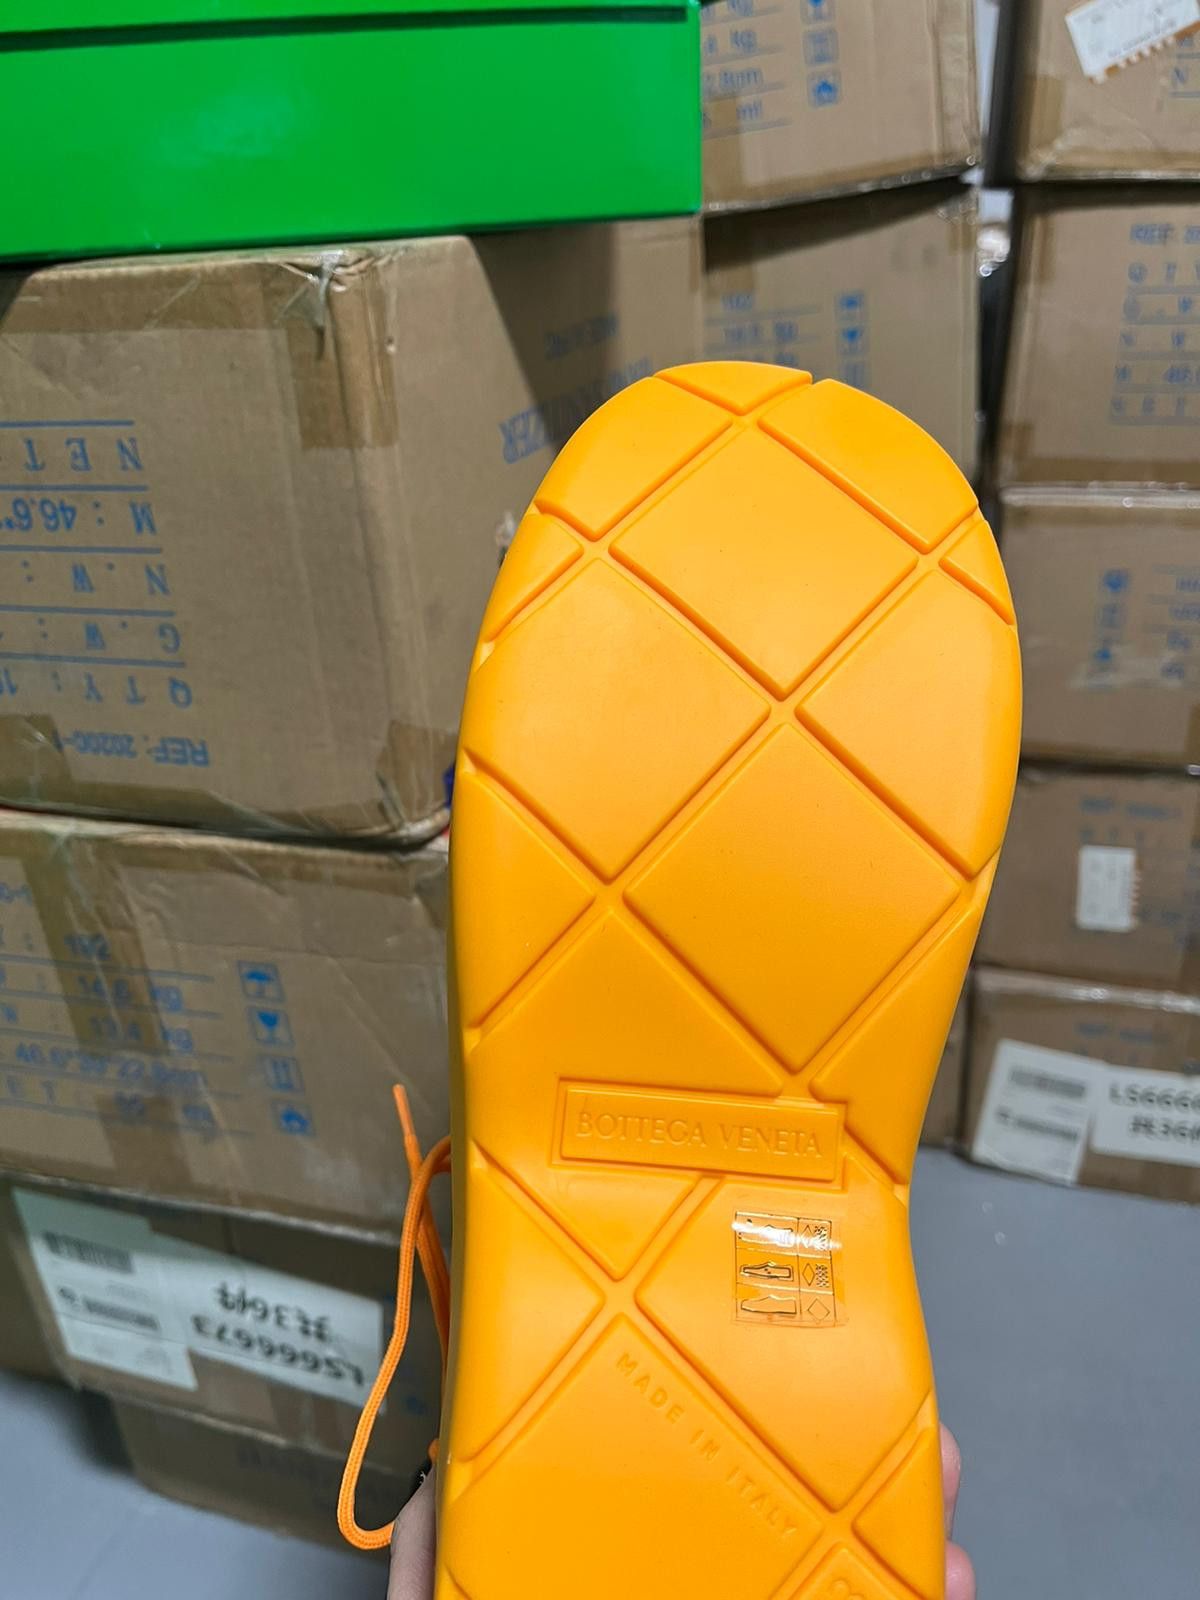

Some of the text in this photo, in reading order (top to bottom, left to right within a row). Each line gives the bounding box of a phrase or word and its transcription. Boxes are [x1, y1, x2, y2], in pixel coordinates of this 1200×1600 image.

[575, 1109, 823, 1160] BOTTEGA VENETA
[616, 1351, 798, 1539] MADE IN ITALY
